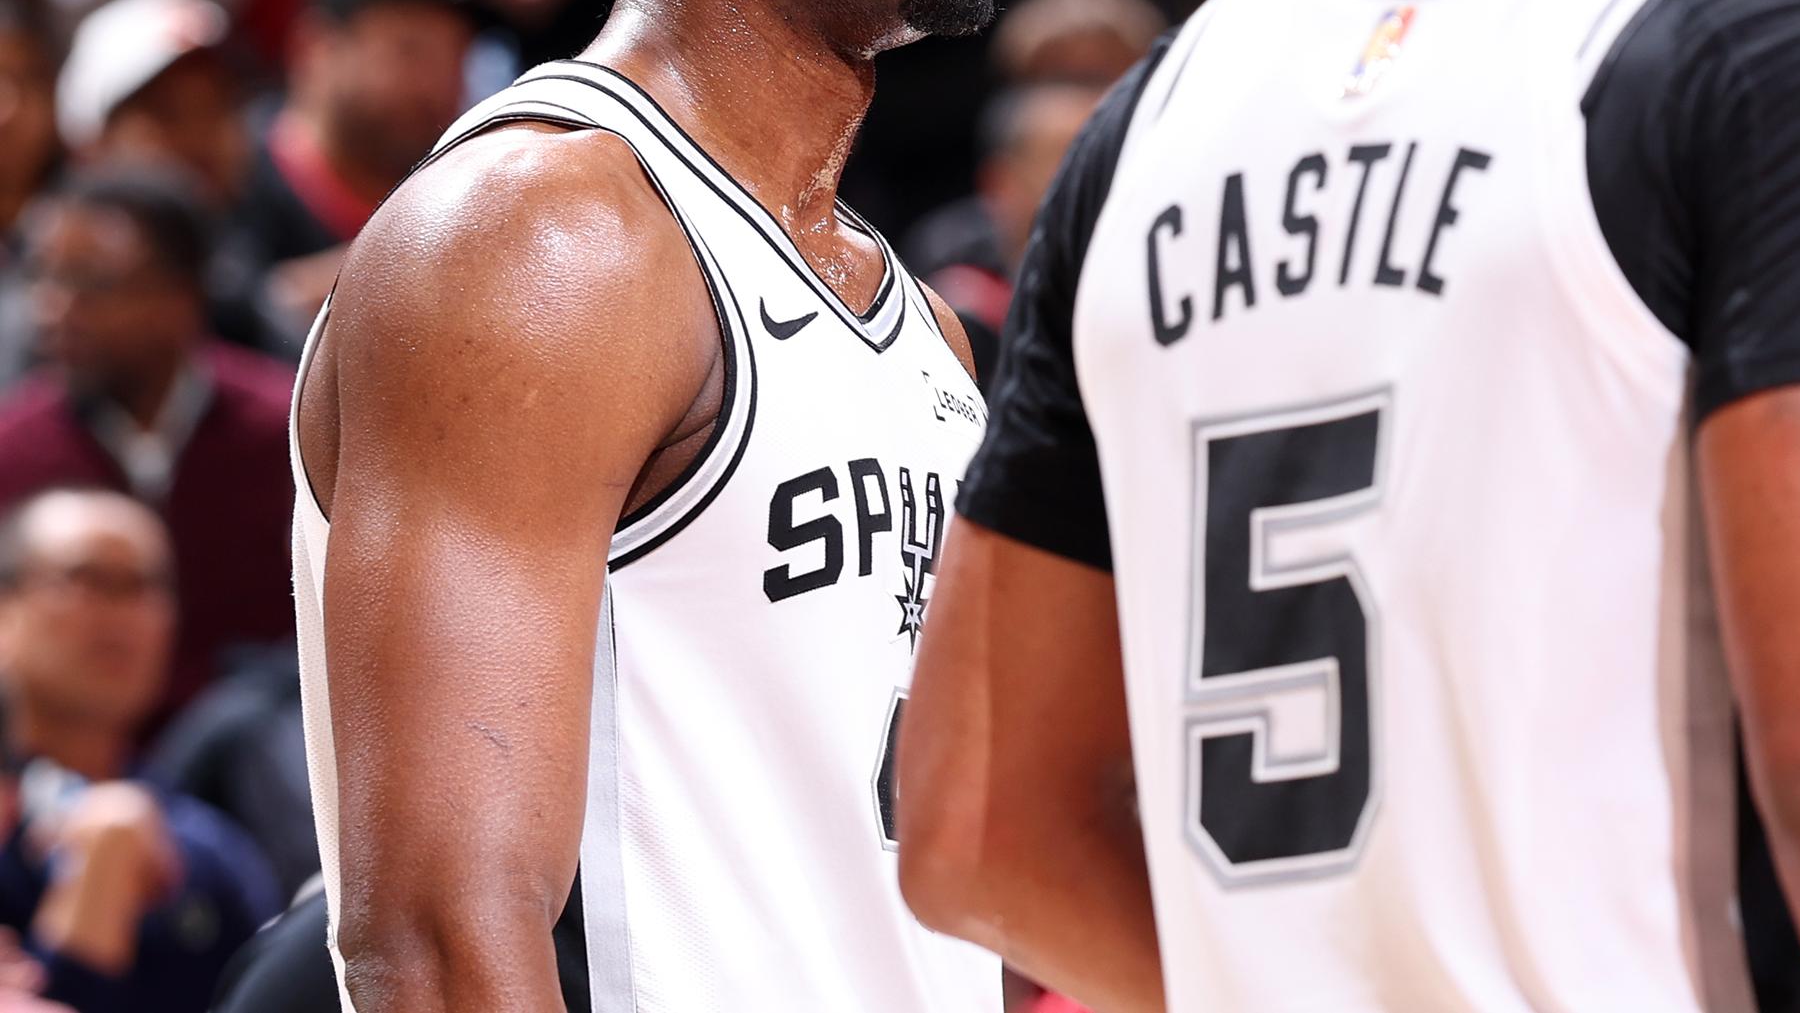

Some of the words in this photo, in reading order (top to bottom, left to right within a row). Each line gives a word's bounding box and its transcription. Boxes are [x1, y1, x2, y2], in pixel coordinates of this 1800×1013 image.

[1147, 140, 1492, 347] CASTLE
[934, 387, 981, 427] LEDGER
[763, 458, 962, 655] SPU
[1185, 383, 1393, 889] 5
